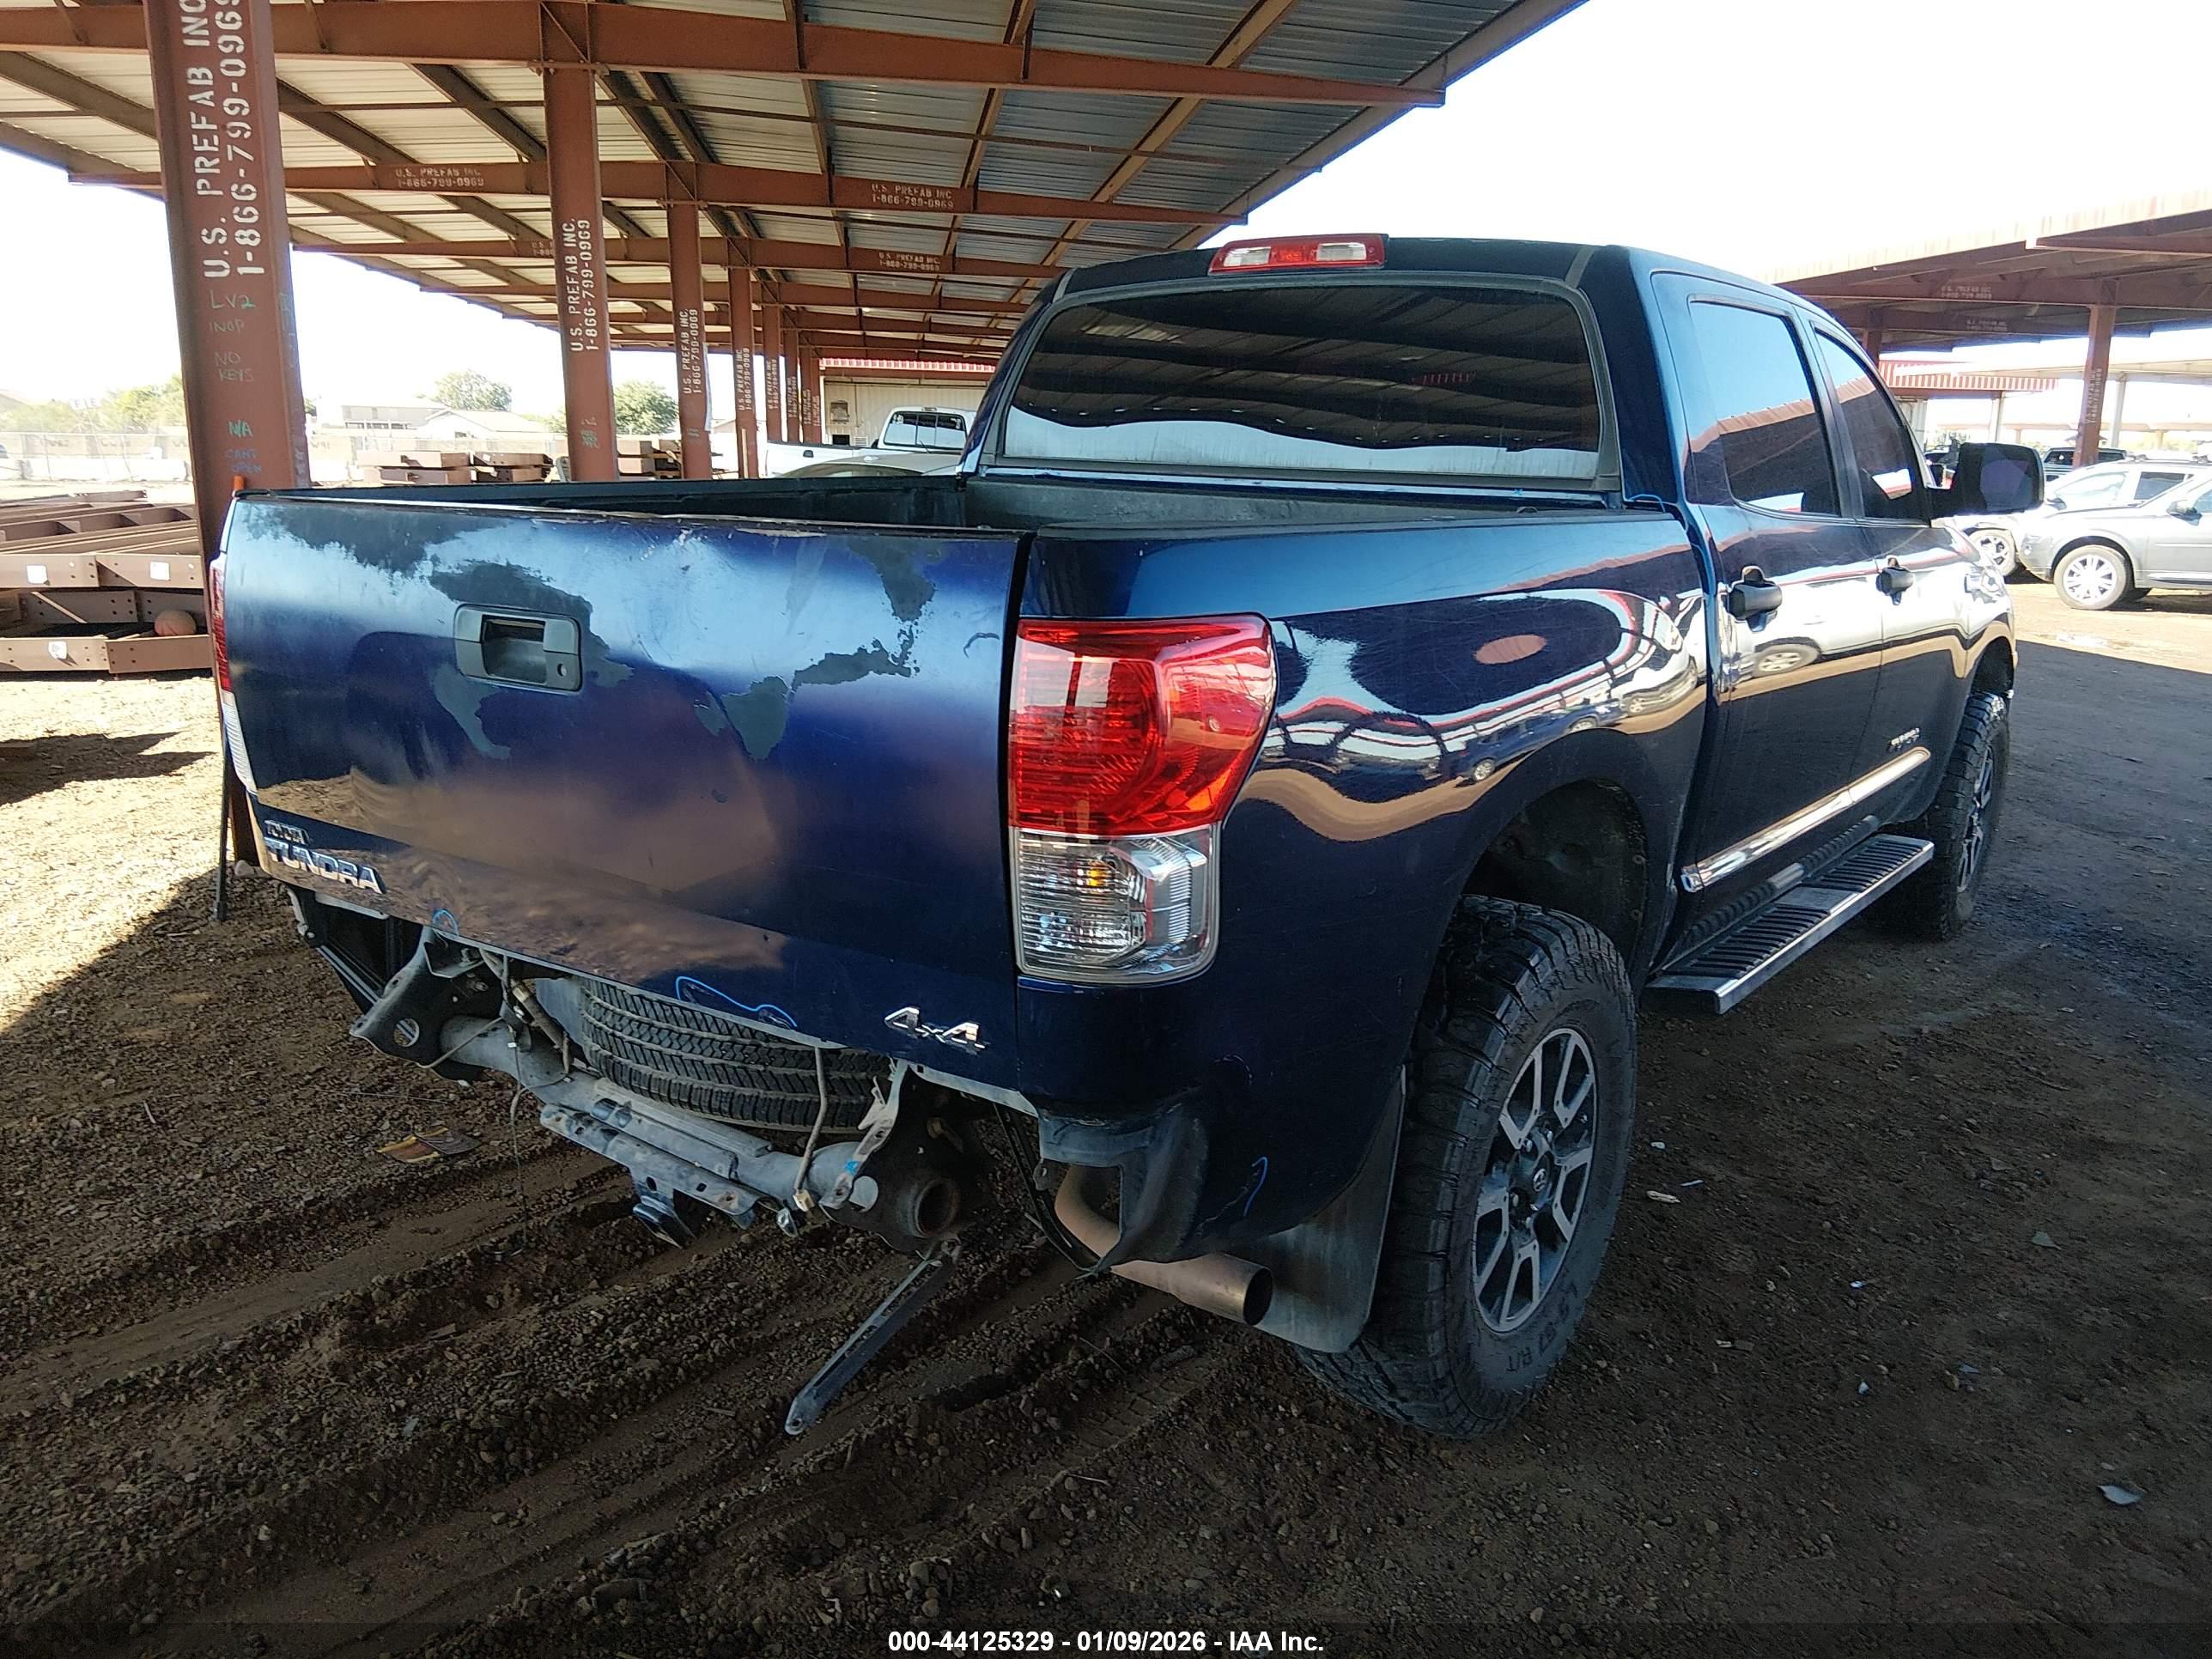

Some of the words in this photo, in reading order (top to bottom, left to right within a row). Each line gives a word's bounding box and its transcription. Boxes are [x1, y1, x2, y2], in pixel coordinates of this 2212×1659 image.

[186, 67, 224, 195] PREFAB
[201, 217, 230, 276] U.S.
[564, 255, 581, 313] PREFAB
[570, 323, 583, 351] U.S.
[680, 332, 690, 370] PREFAB
[264, 836, 386, 895] TUNDRA
